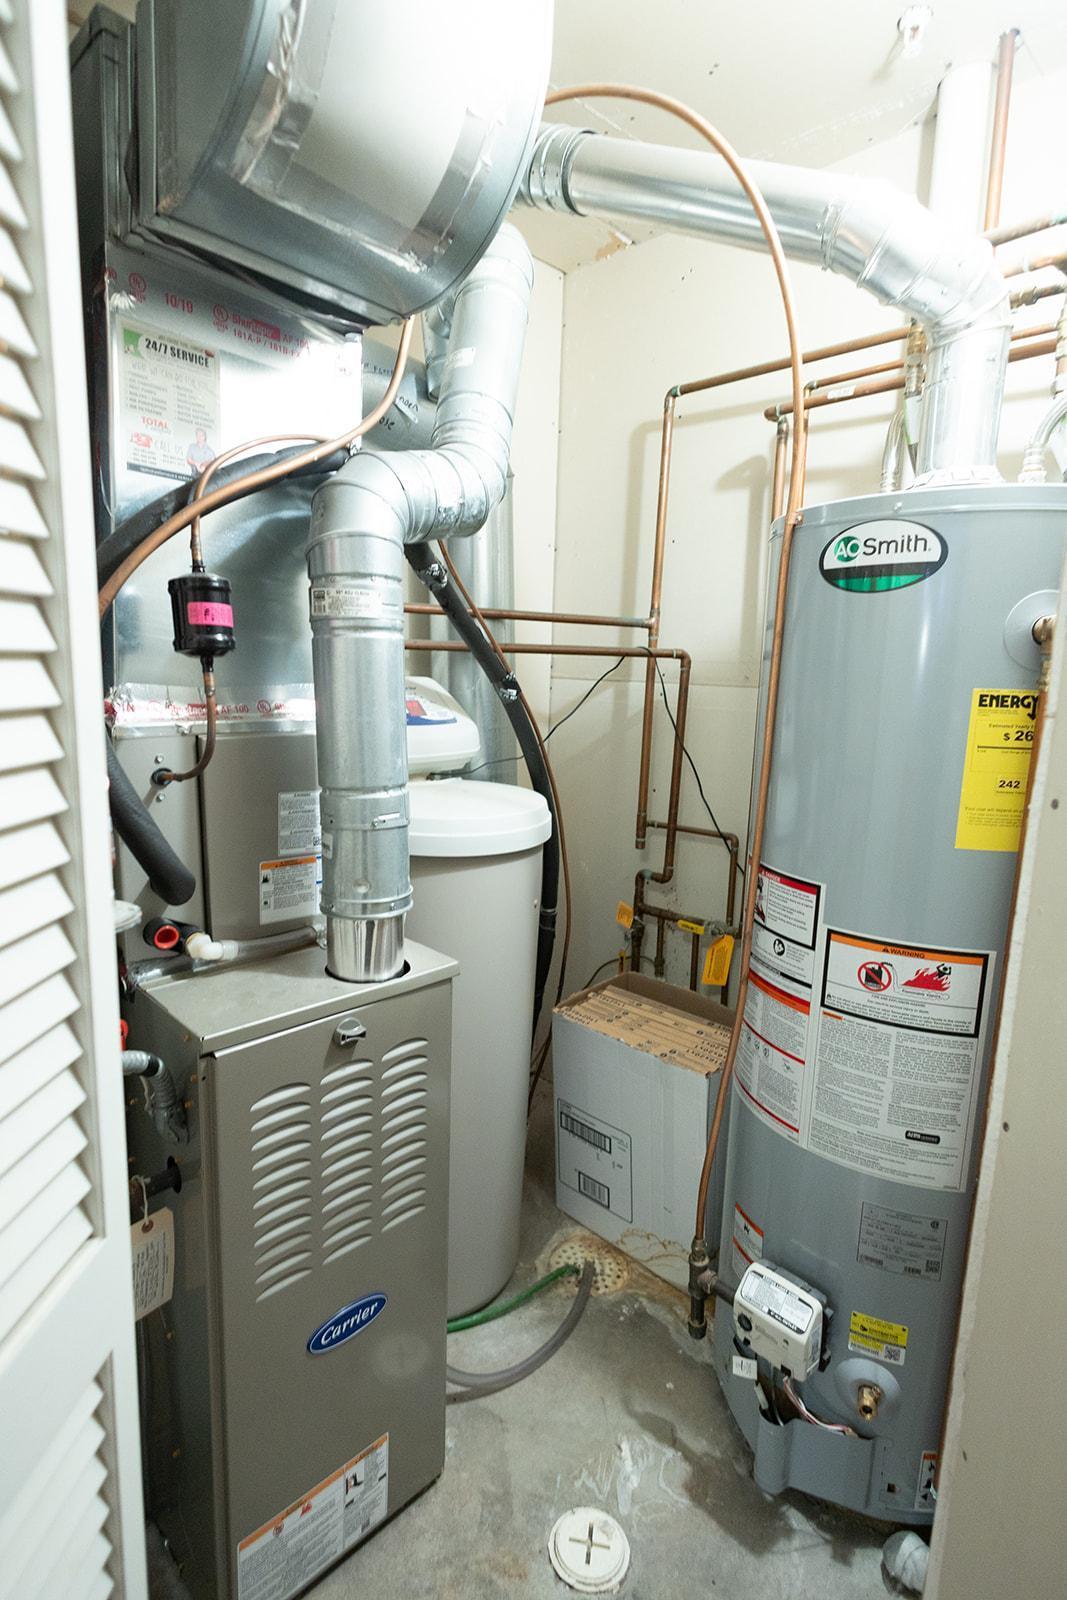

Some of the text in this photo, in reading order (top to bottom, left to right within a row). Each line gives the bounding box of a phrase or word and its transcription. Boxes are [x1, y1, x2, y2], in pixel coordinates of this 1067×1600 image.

[145, 337, 168, 354] 24/7
[170, 345, 209, 368] SERVICE
[141, 416, 168, 429] TOTAL
[862, 534, 928, 556] Smith
[998, 780, 1021, 789] 242
[890, 949, 926, 959] WARNING
[320, 1302, 378, 1346] Carrier
